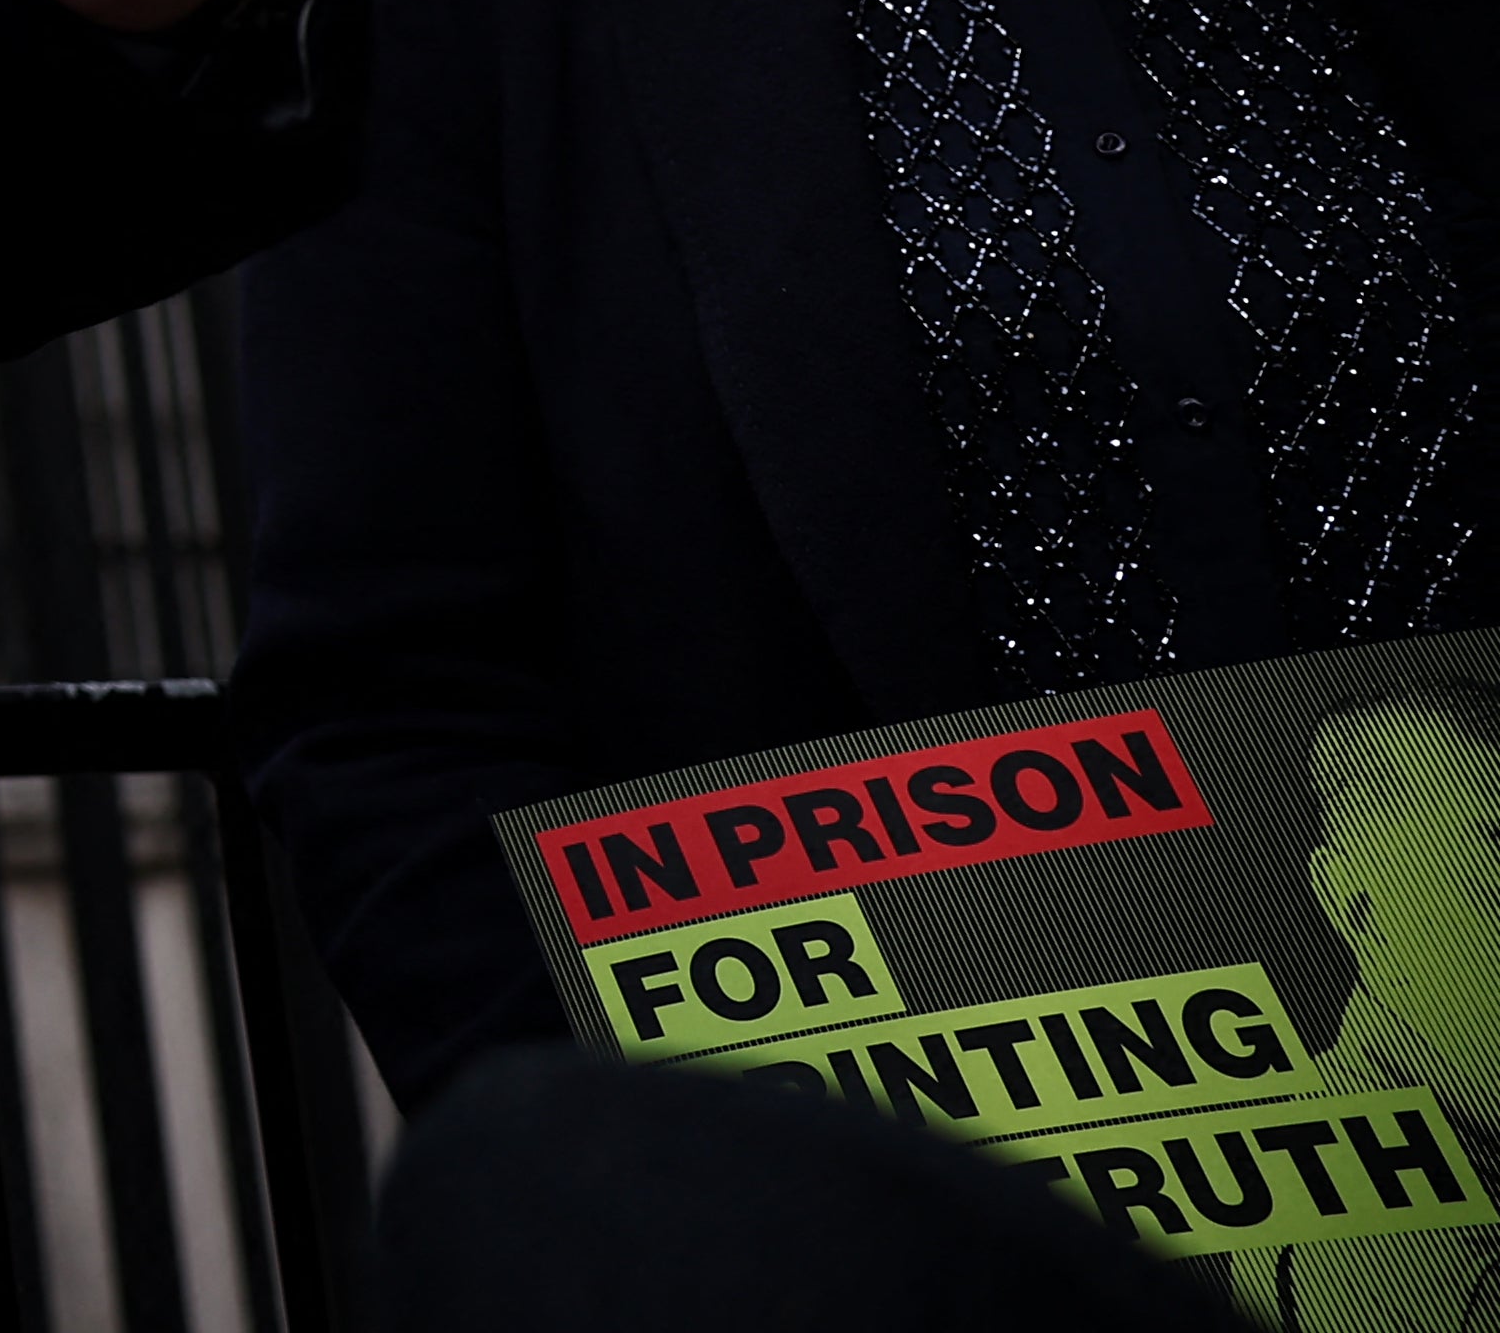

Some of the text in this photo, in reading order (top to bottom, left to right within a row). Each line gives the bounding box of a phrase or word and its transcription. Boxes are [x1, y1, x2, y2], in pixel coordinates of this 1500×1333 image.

[562, 730, 1180, 921] IN PRISON
[610, 918, 878, 1040] FOR
